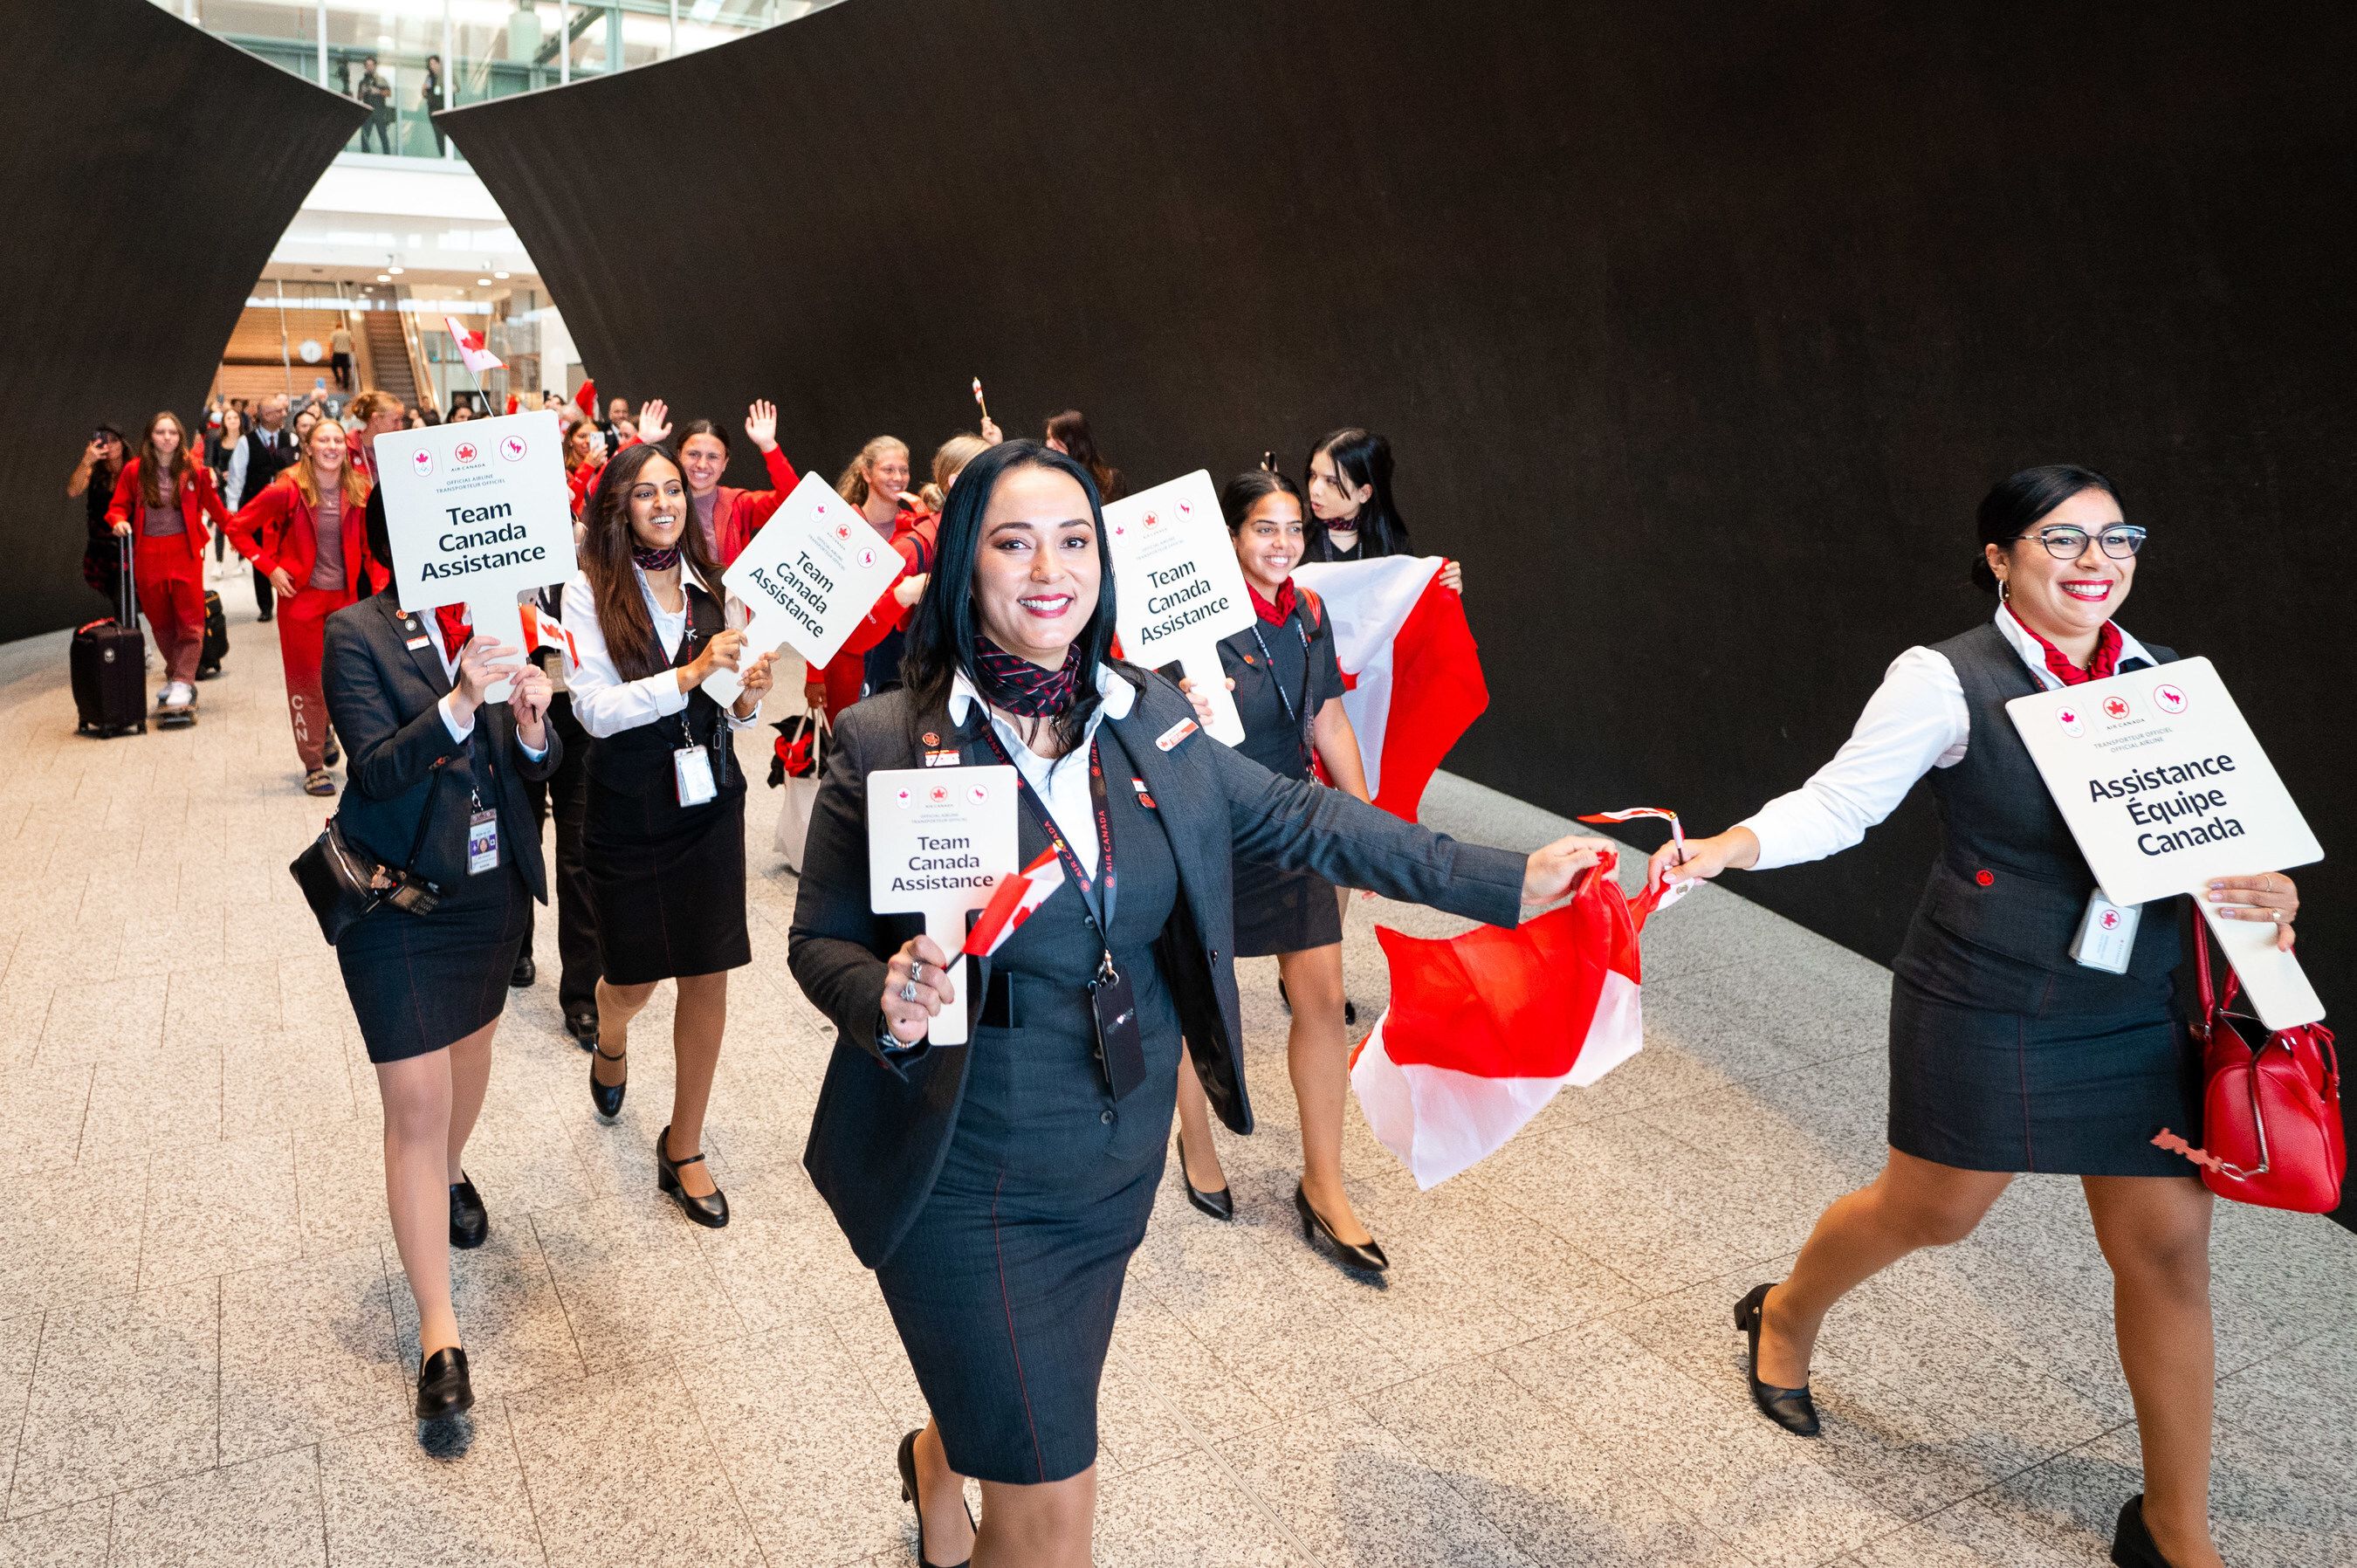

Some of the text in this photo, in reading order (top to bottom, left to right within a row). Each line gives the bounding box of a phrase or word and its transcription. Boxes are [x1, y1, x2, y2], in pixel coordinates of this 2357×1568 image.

[436, 482, 481, 493] TRANSPORTEUR
[471, 473, 494, 482] AIRLINE
[446, 503, 512, 526] Team
[438, 524, 526, 552] Canada
[421, 546, 546, 581] Assistance
[796, 550, 835, 594] Team
[1147, 560, 1196, 589] Team
[749, 567, 824, 638] Assistance
[776, 562, 828, 615] Canada
[1148, 579, 1212, 615] Canada
[1141, 595, 1229, 645] Assistance
[292, 695, 309, 742] CAN
[2119, 718, 2146, 727] CANADA
[2088, 753, 2237, 803] Assistance
[2126, 787, 2227, 826] Équipe
[917, 836, 970, 851] Team
[1044, 820, 1083, 877] AIR CAADA
[1098, 809, 1111, 853] CANADA
[2137, 816, 2246, 856] Canada
[909, 854, 980, 871] Canada
[891, 875, 993, 892] Assistance
